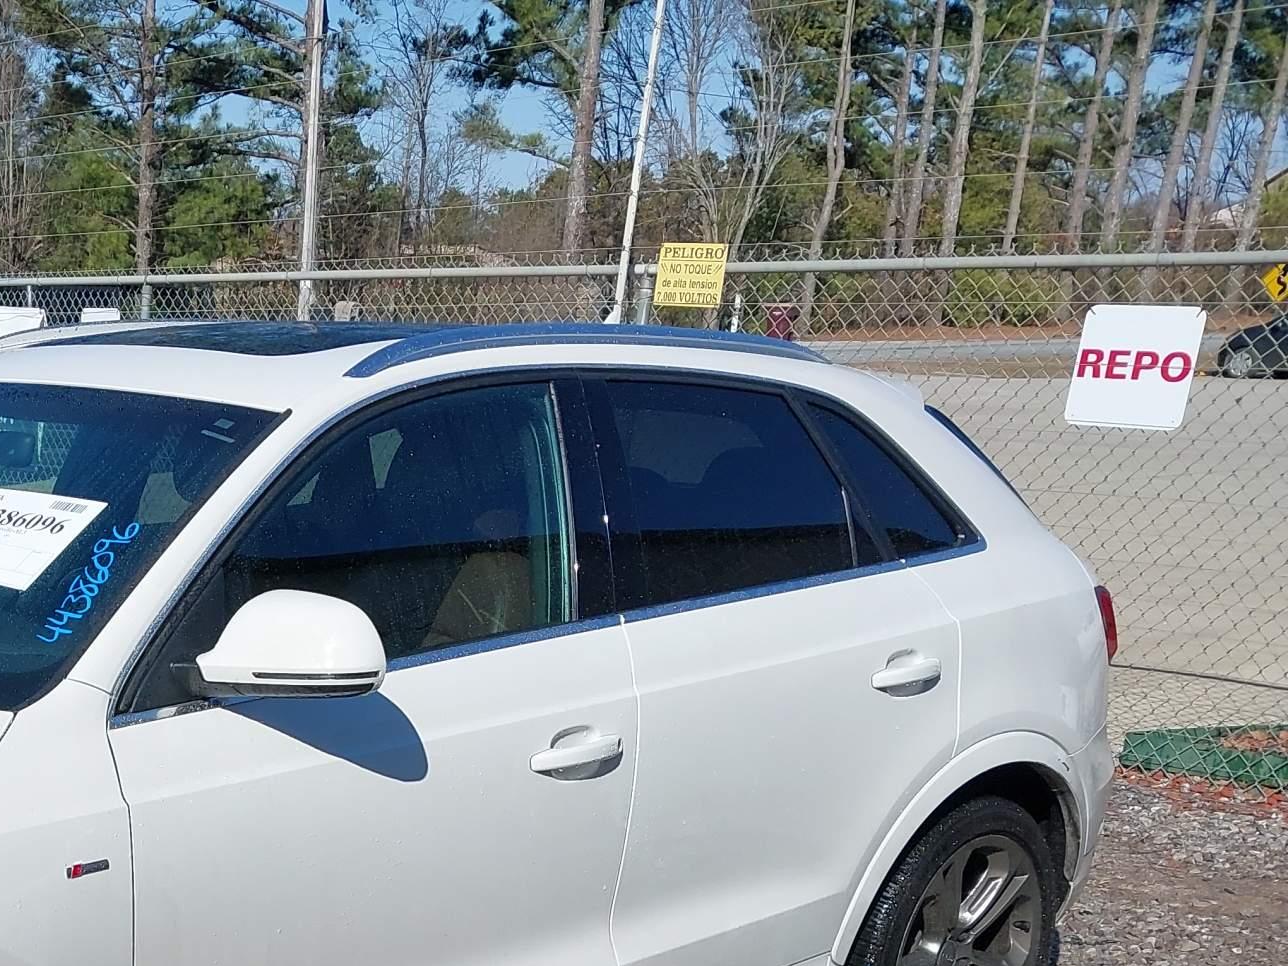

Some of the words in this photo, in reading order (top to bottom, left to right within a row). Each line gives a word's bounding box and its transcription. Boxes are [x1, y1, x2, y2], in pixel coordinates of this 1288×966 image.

[663, 247, 725, 260] PELIGRO
[669, 263, 682, 274] NO
[683, 263, 713, 275] TOQUE
[662, 278, 671, 288] de
[688, 279, 718, 289] tension
[679, 292, 718, 304] VOLTIOS
[1076, 348, 1192, 383] REPO
[35, 521, 141, 645] 44386096
